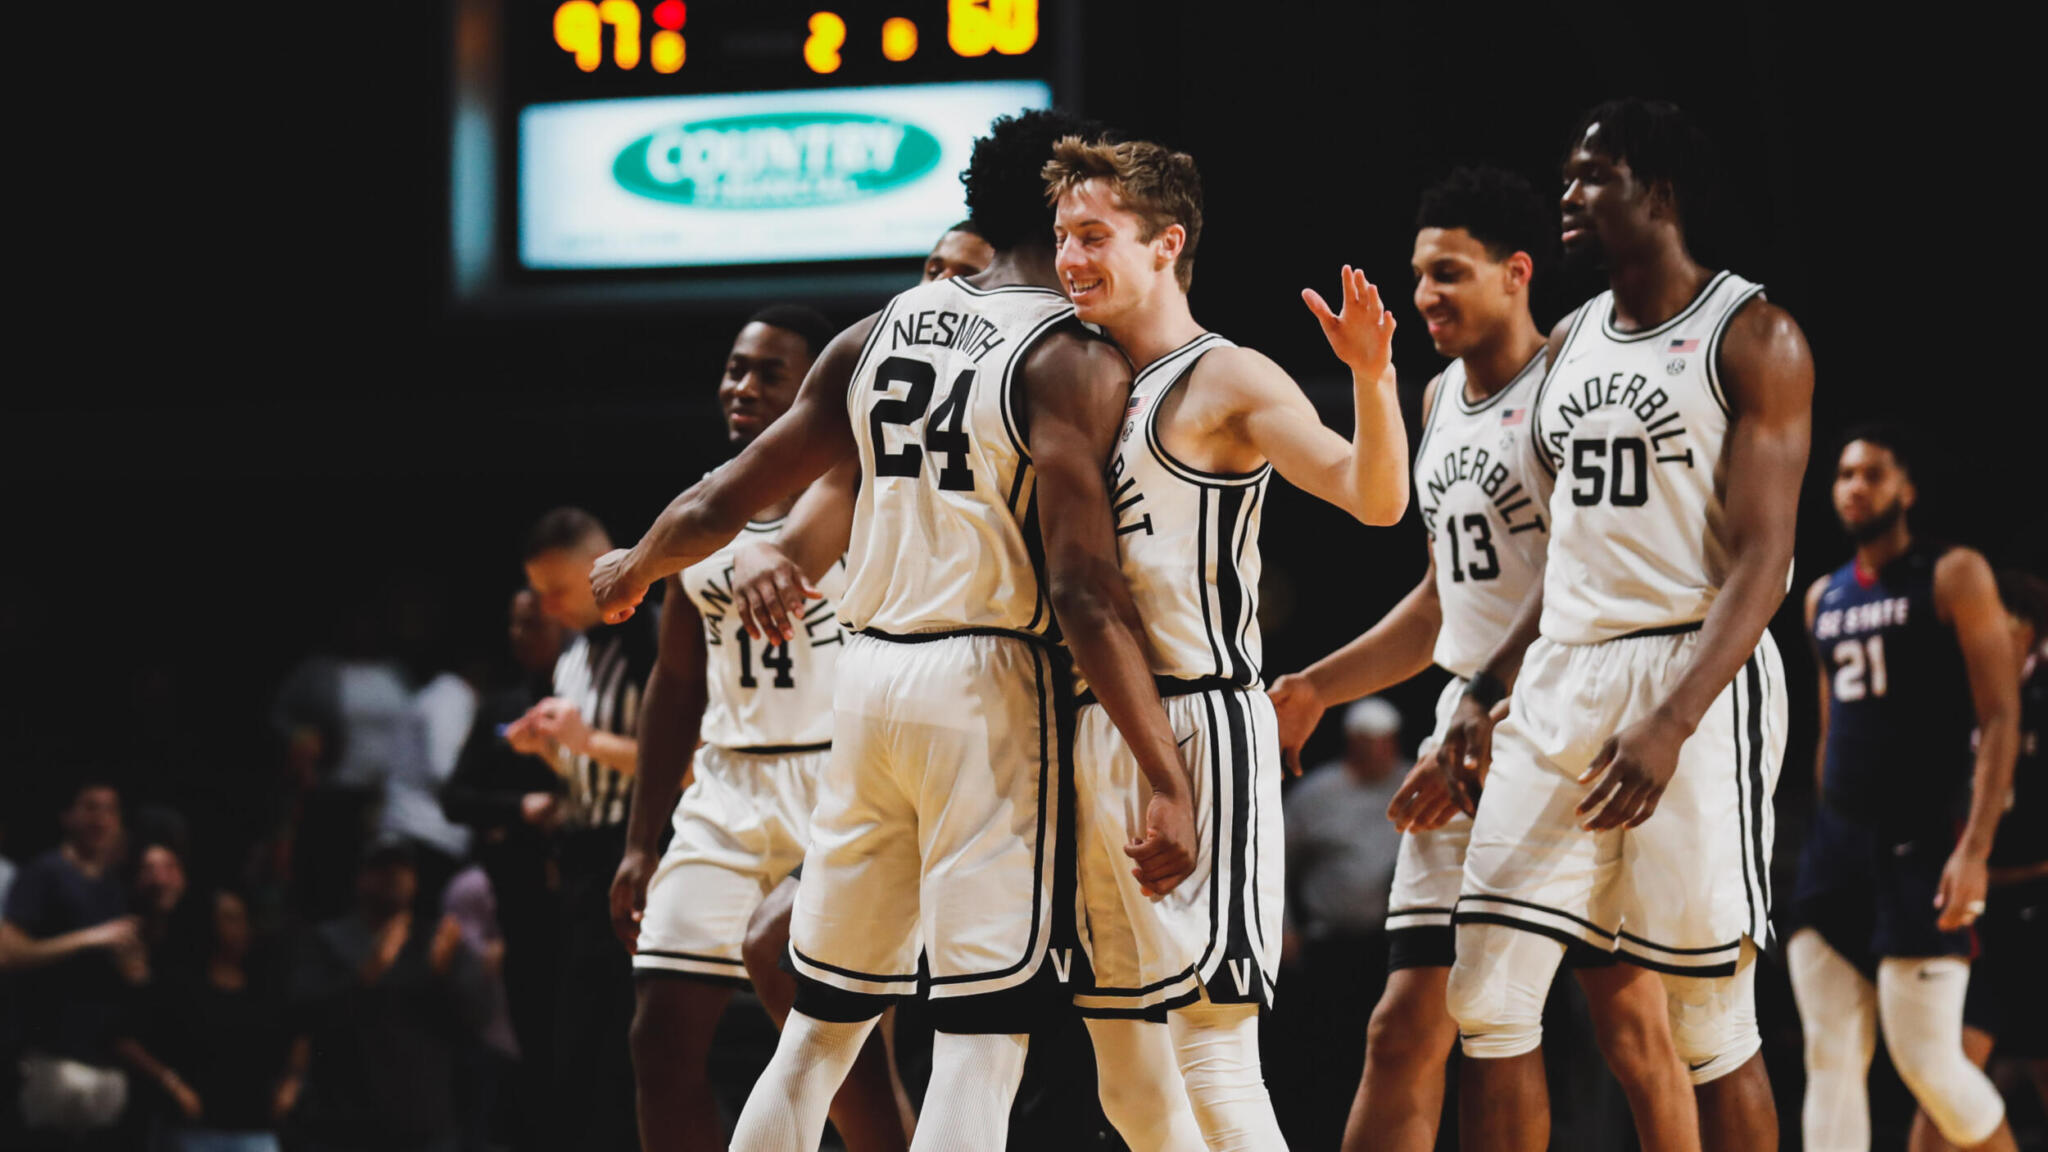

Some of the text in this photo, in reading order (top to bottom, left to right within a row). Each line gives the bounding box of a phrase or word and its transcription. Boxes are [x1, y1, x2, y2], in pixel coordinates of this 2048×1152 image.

[645, 121, 906, 185] COUNTRY
[891, 310, 1006, 364] NESMITH
[869, 355, 977, 492] 24
[1571, 436, 1649, 507] 50
[1446, 513, 1501, 582] 13
[1844, 597, 1909, 635] STATE
[735, 624, 795, 689] 14
[1833, 634, 1888, 702] 21
[1049, 947, 1073, 983] V
[1227, 957, 1251, 997] V
